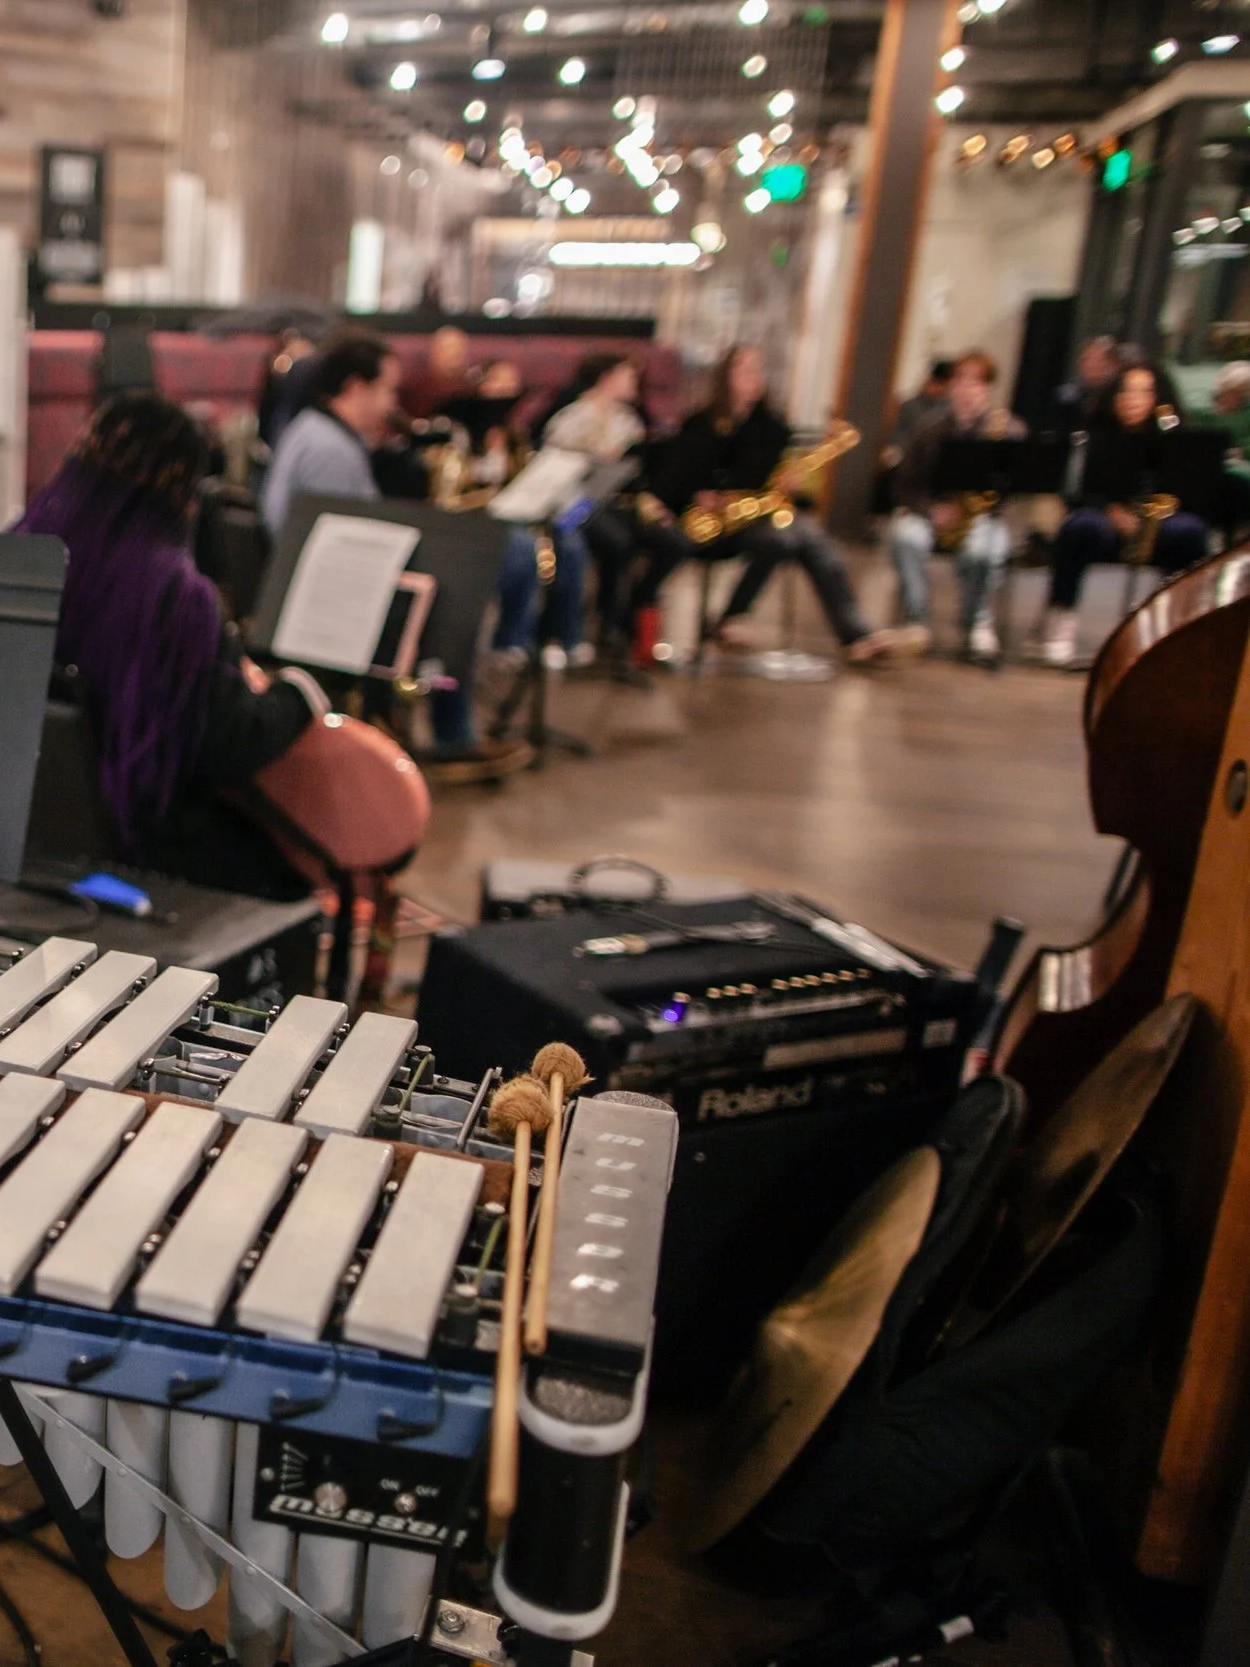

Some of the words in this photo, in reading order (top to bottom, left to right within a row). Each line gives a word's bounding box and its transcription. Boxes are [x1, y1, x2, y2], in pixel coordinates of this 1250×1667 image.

[697, 1077, 813, 1121] Roland
[380, 1478, 400, 1491] ON
[415, 1485, 440, 1498] OFF
